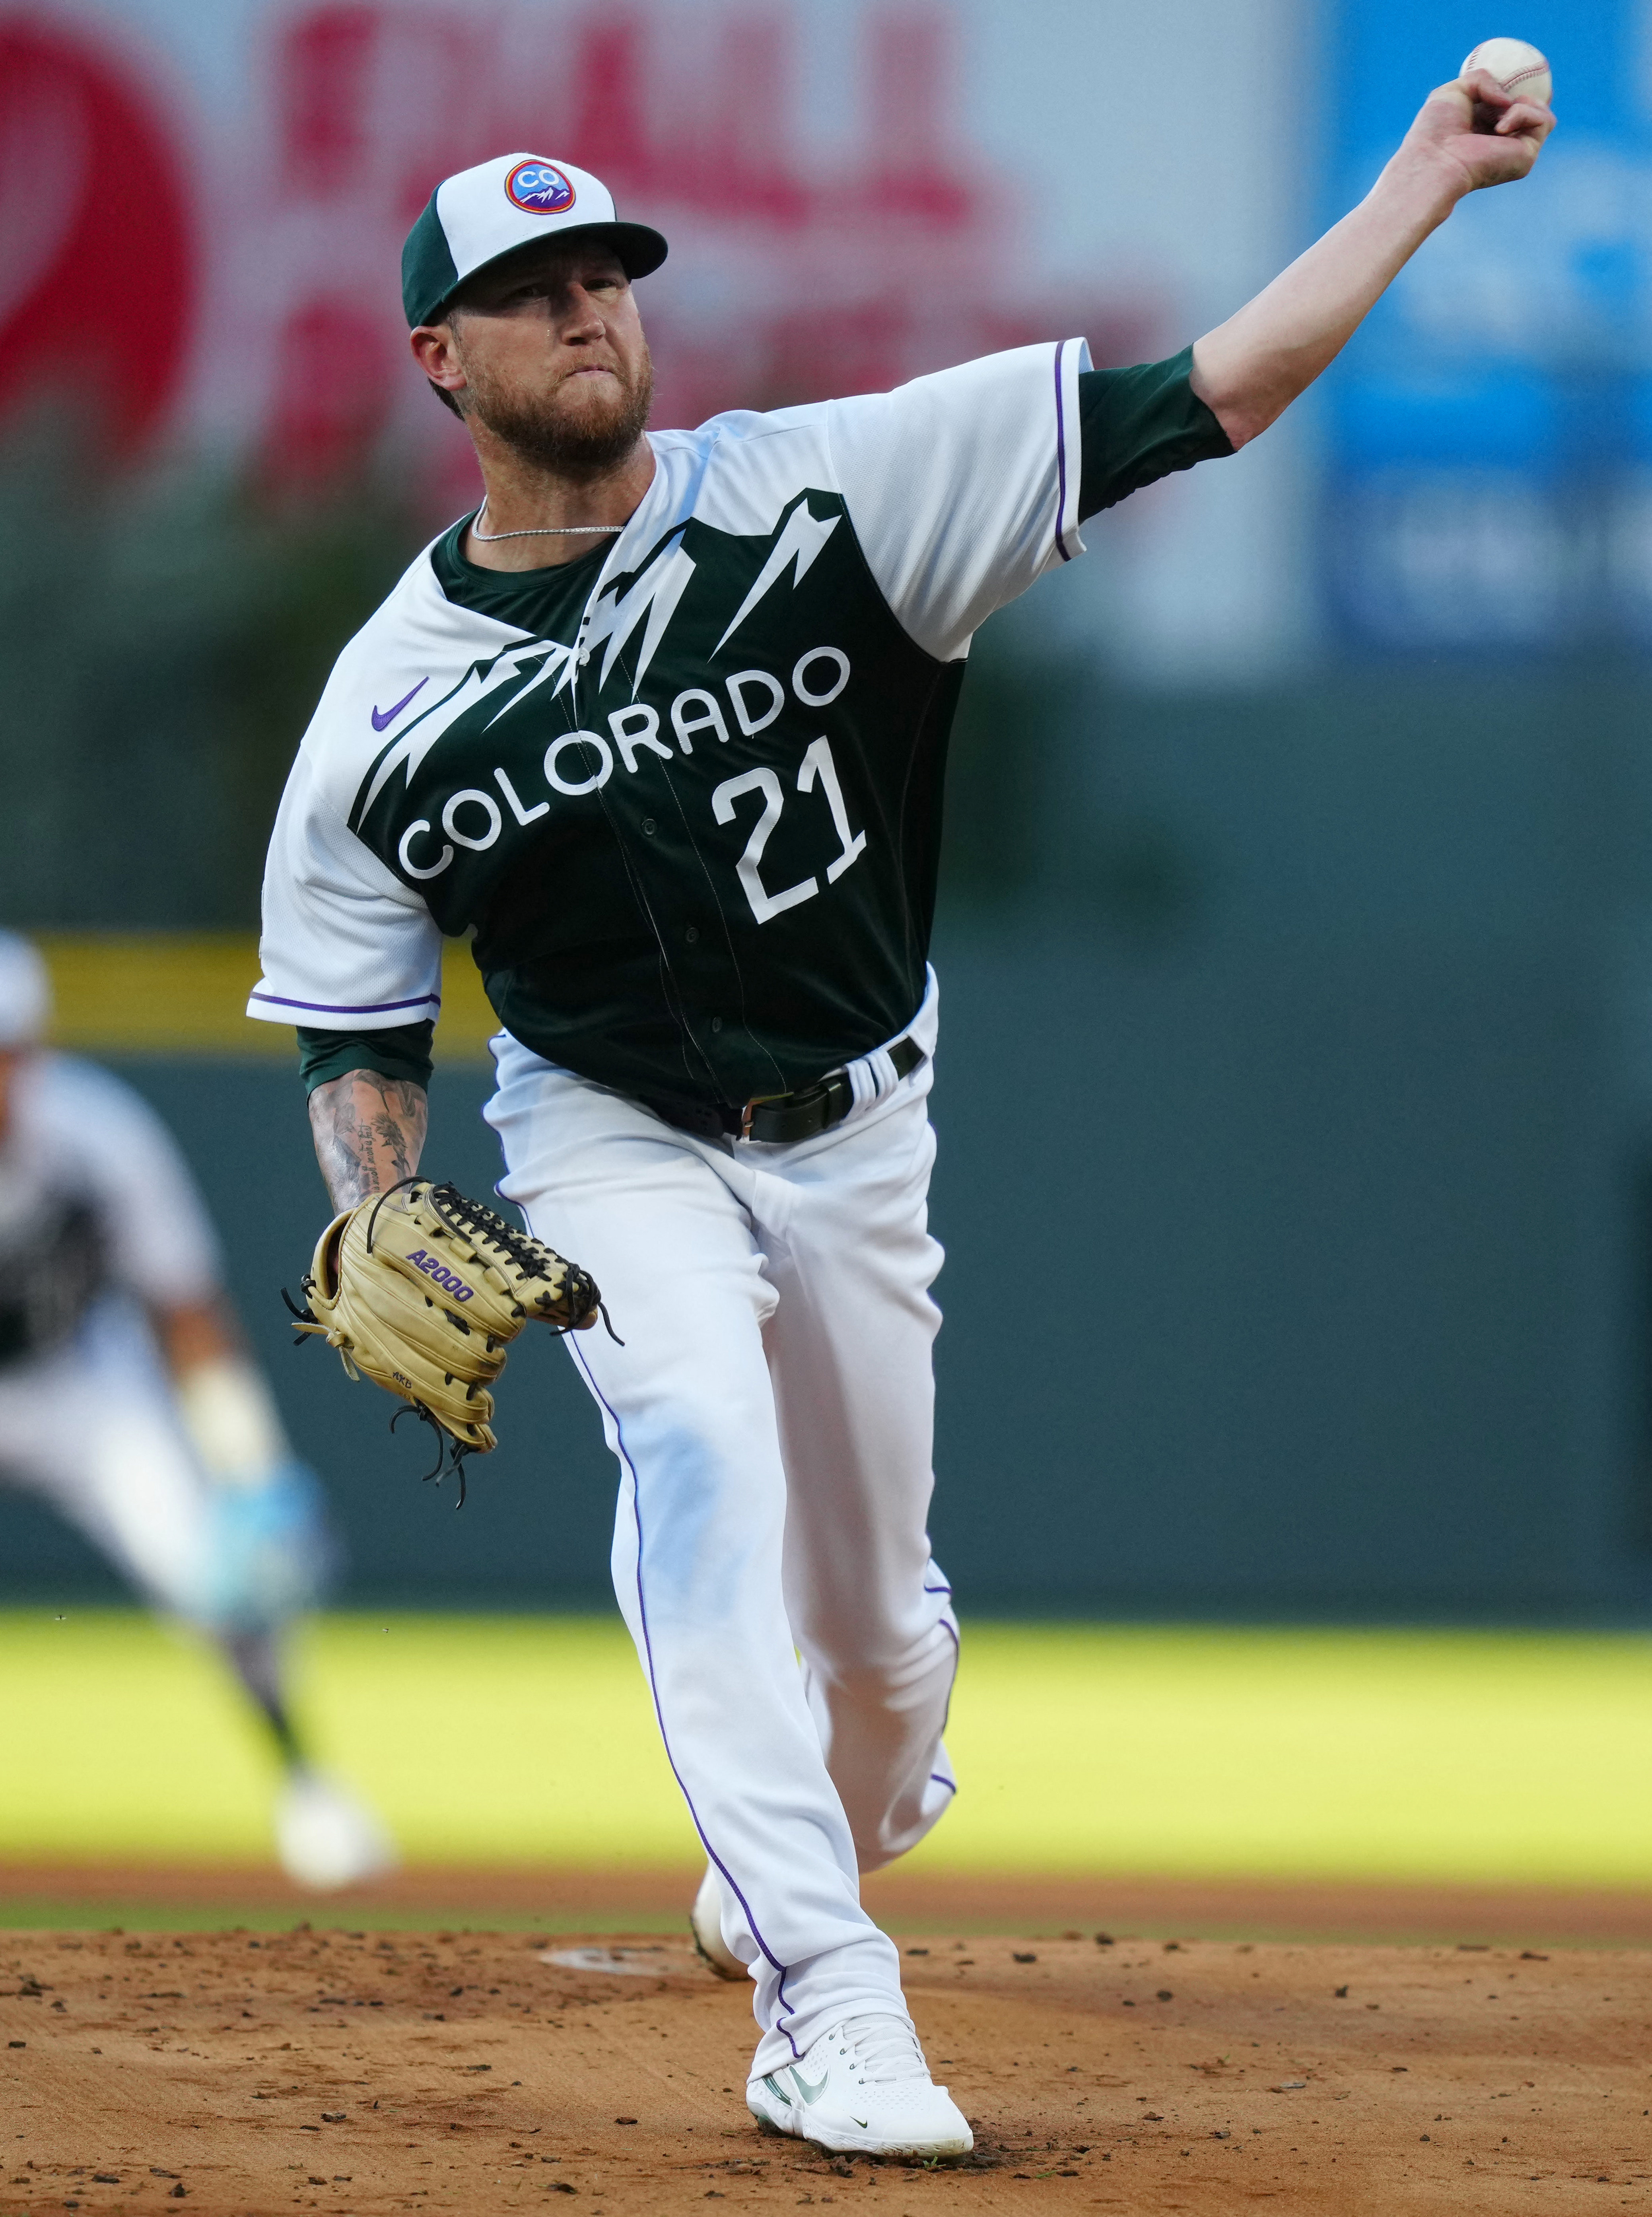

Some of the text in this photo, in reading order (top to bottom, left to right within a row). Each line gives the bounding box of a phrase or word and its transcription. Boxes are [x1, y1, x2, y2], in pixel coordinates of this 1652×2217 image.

[517, 169, 560, 188] CO
[398, 646, 851, 880] COLORADO
[711, 735, 867, 925] 21
[405, 1249, 474, 1302] A2000
